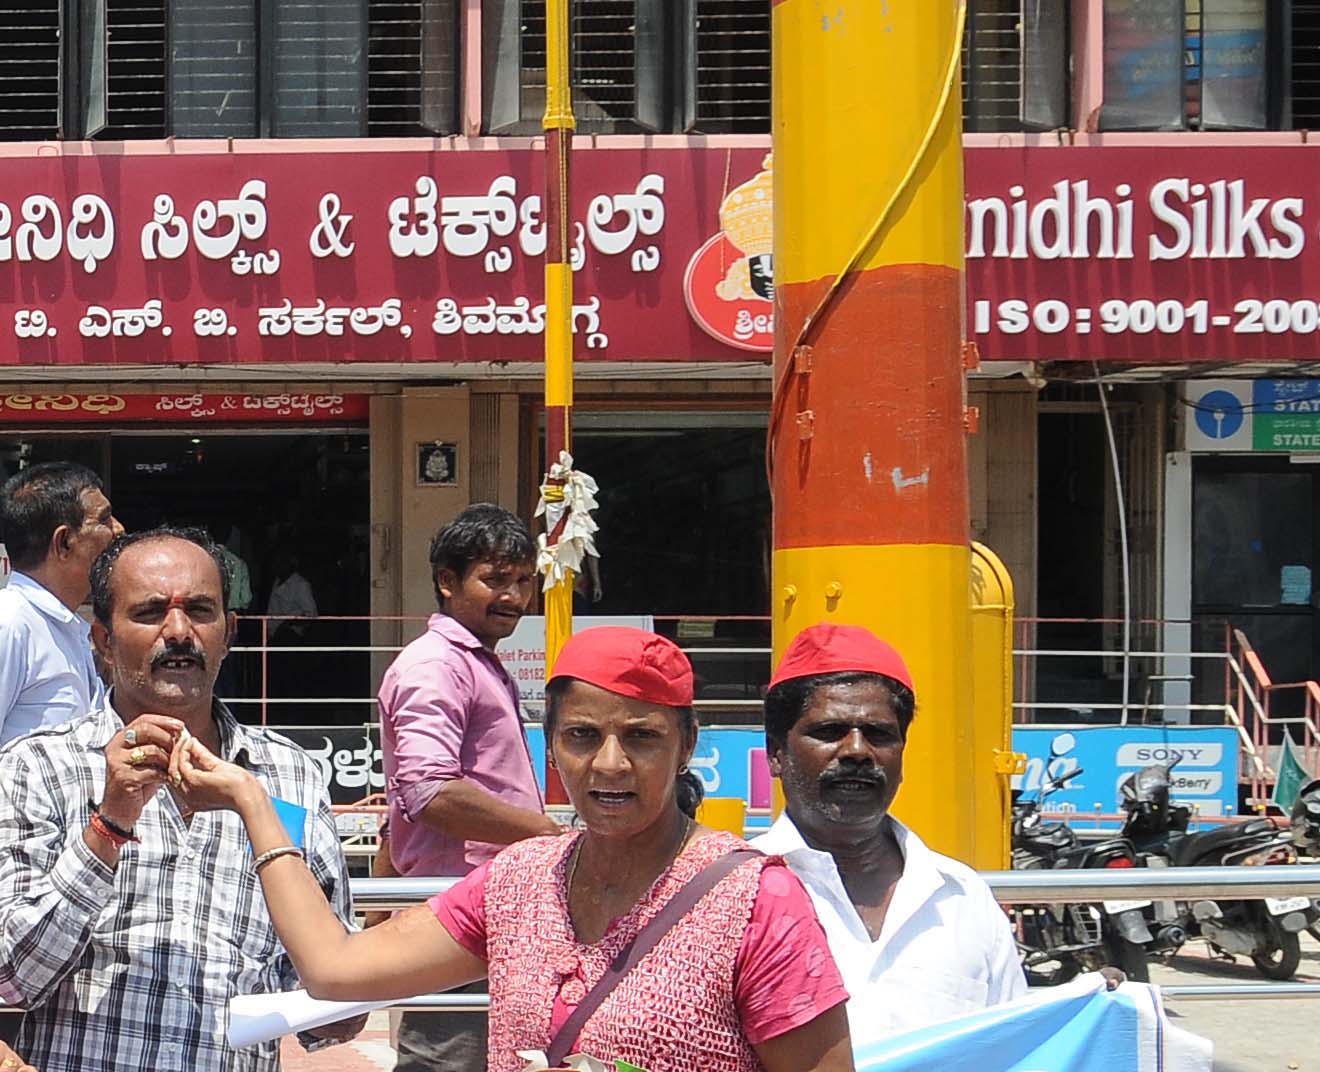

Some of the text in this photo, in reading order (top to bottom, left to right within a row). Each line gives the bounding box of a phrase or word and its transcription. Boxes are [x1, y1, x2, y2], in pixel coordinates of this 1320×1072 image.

[140, 180, 281, 275] ಸಿಲ್ಕ್ಸ್
[310, 193, 355, 257] &
[966, 178, 1305, 260] nidhi Silks
[14, 310, 57, 337] ಟಿ.
[79, 299, 172, 336] ಎಸ್.
[193, 308, 237, 336] ಬಿ.
[221, 396, 238, 409] &
[1137, 749, 1203, 760] SONY
